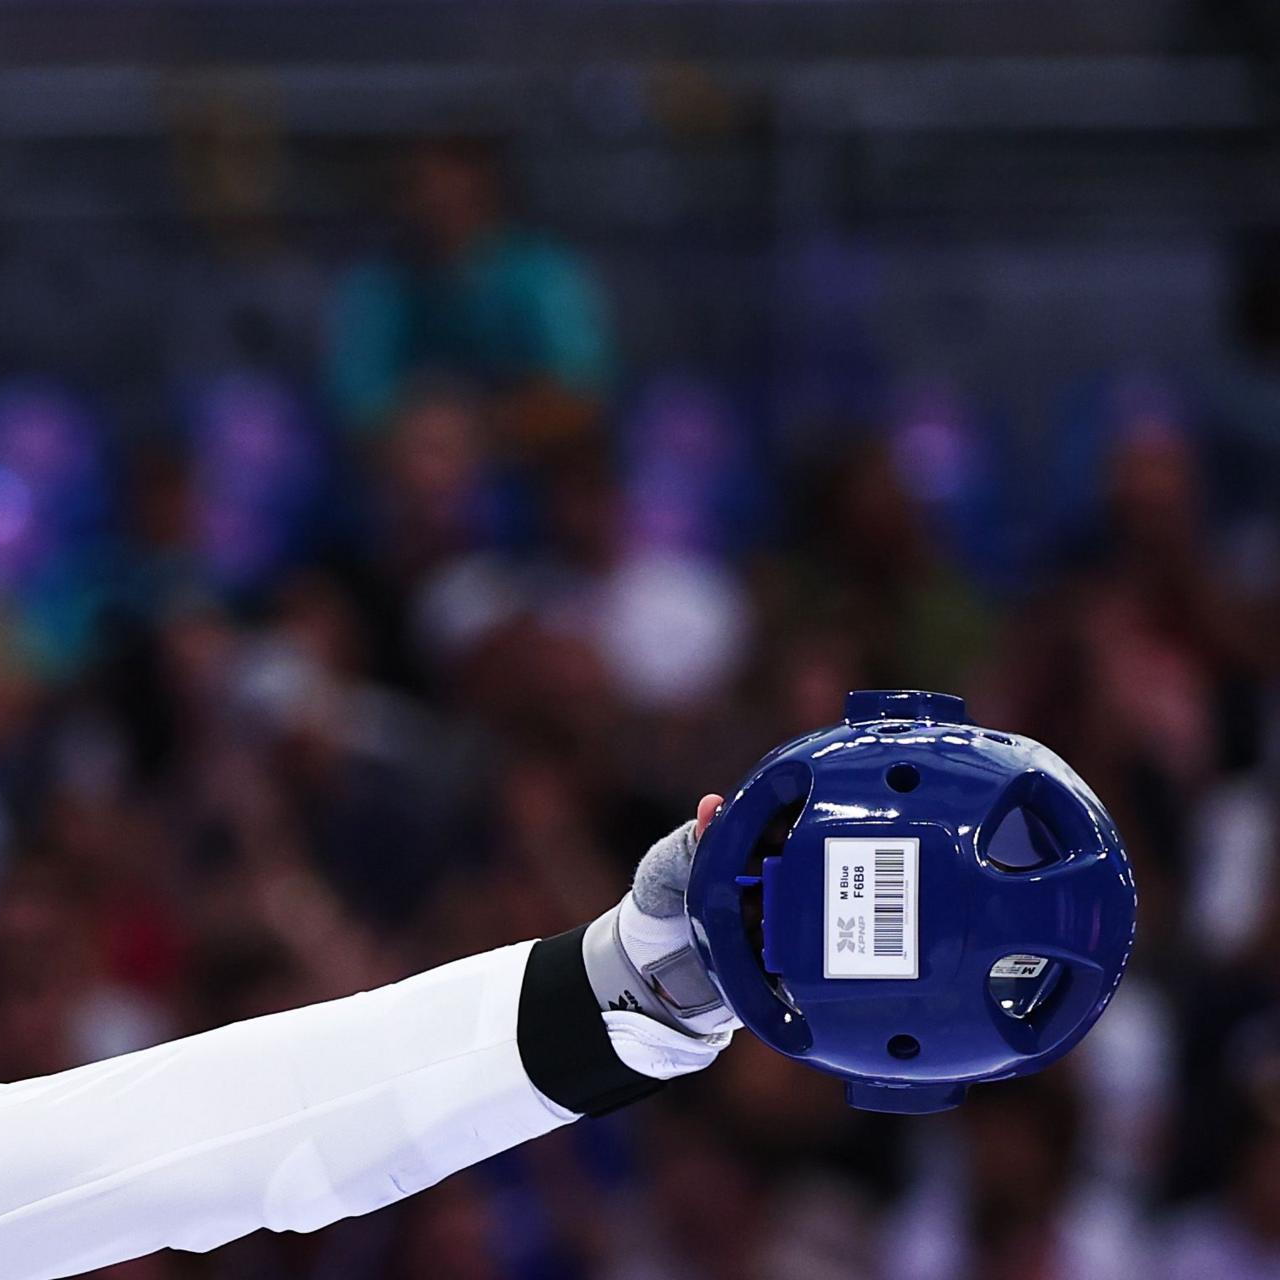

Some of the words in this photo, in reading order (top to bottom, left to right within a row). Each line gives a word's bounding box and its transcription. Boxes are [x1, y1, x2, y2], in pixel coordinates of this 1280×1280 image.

[839, 865, 849, 888] Blue
[853, 865, 865, 899] F6B8
[839, 891, 849, 900] M
[857, 915, 867, 954] KPNP
